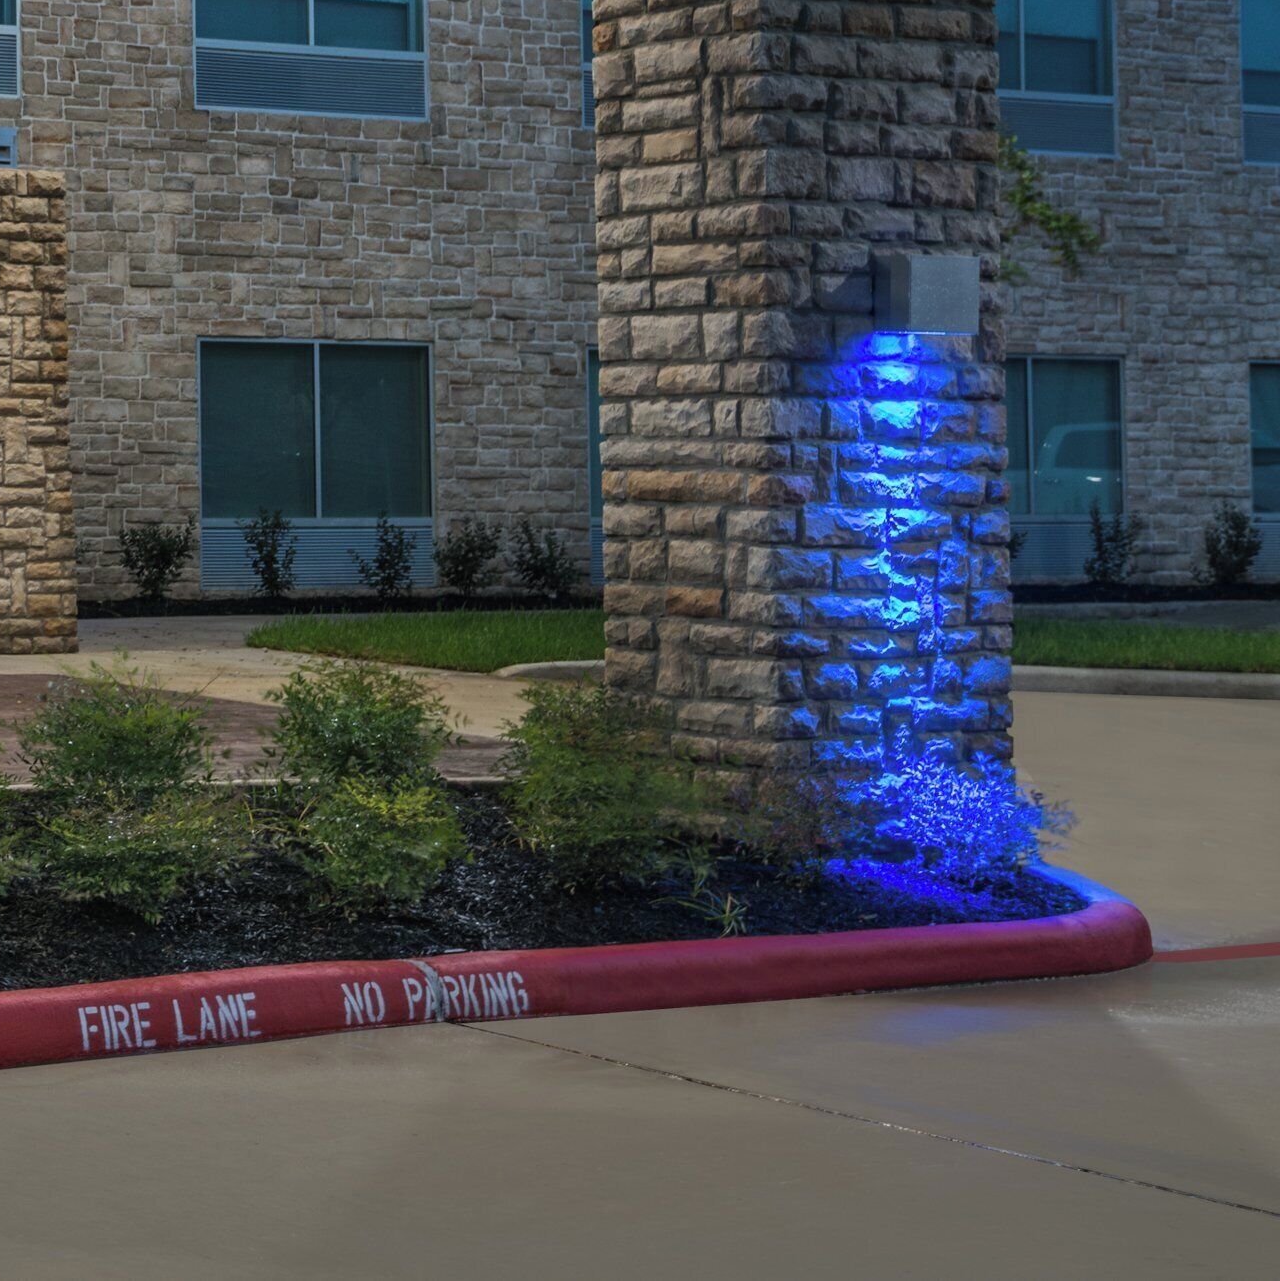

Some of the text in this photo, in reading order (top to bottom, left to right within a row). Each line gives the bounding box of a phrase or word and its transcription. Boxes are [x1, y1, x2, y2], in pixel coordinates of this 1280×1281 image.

[78, 992, 262, 1051] FIRE LANE
[340, 971, 529, 1025] NO PARKING
